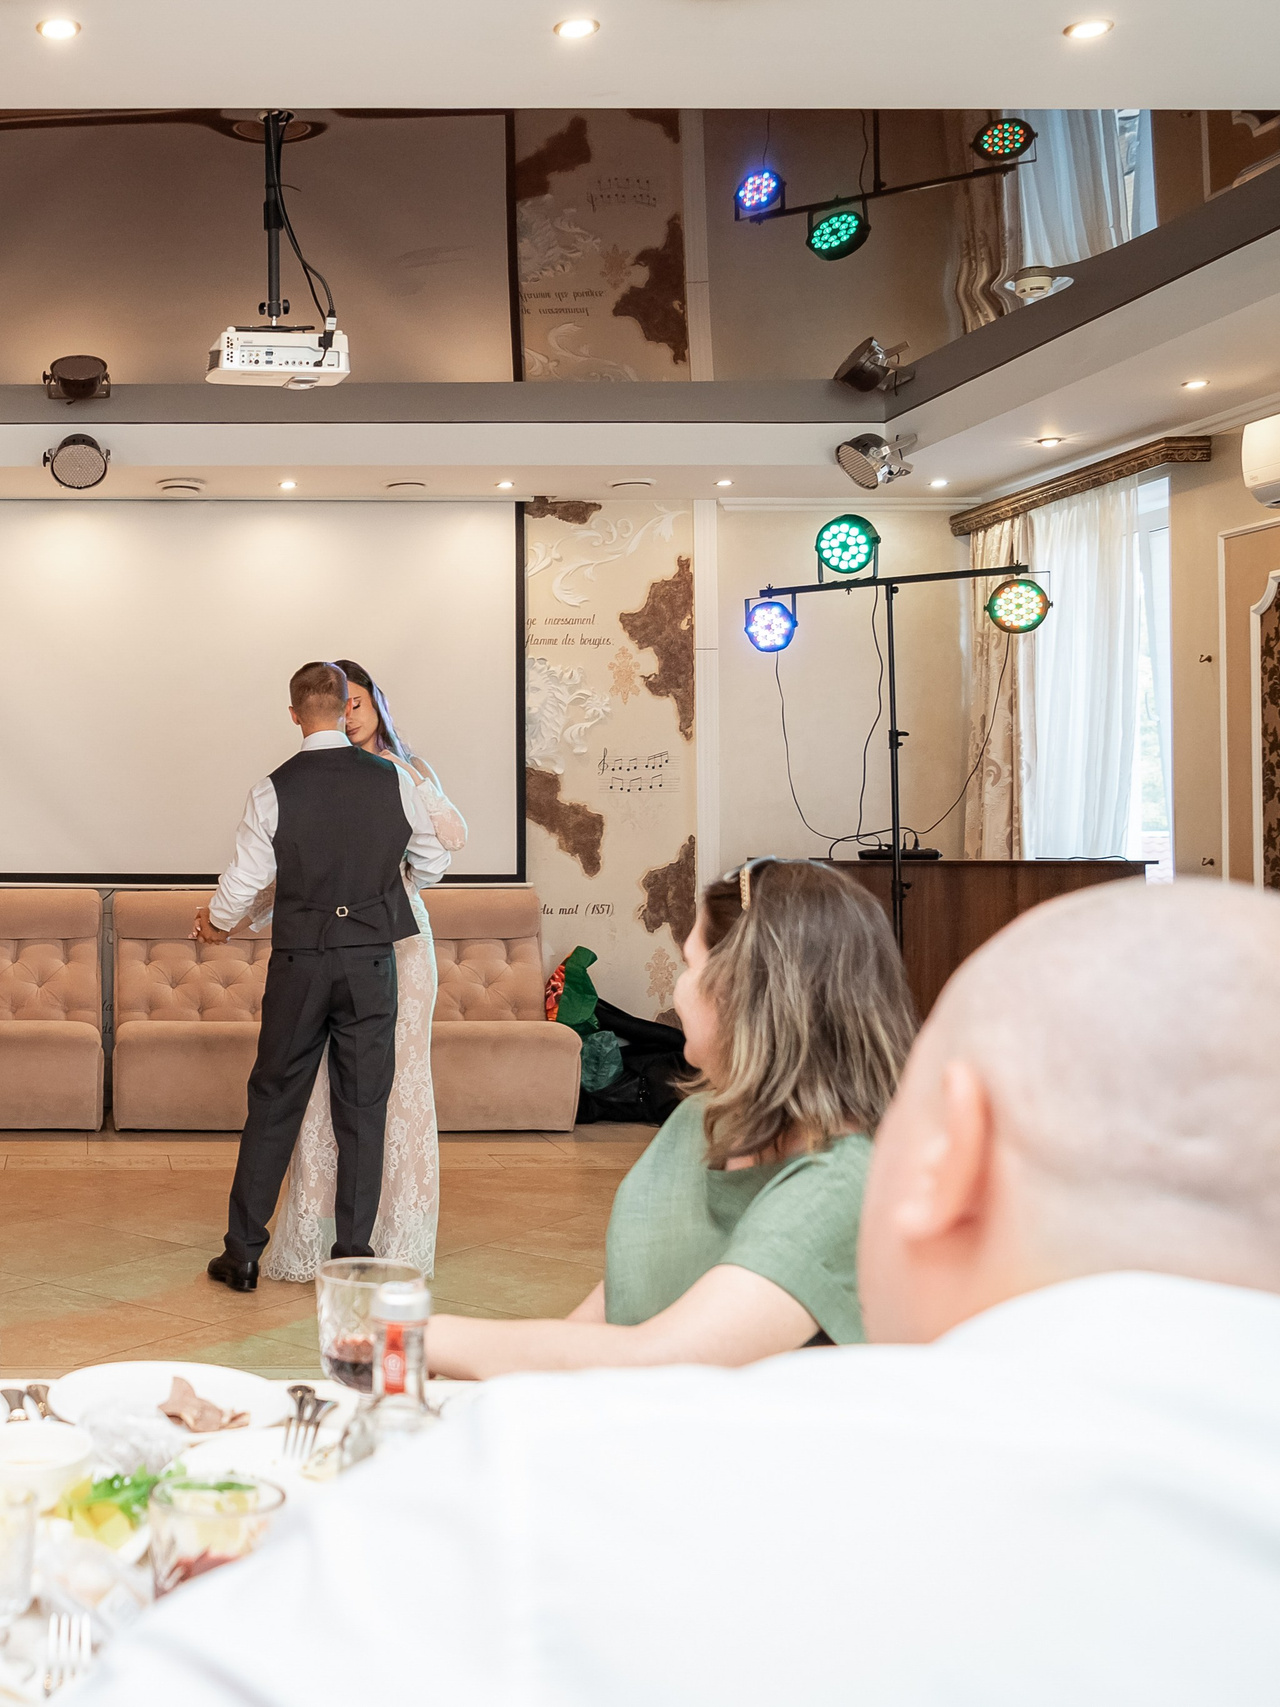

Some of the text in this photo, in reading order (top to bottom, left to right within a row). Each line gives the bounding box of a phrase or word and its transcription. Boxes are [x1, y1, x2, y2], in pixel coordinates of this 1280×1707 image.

[561, 633, 575, 645] des
[558, 904, 579, 915] mal
[585, 902, 614, 917] (1857)
